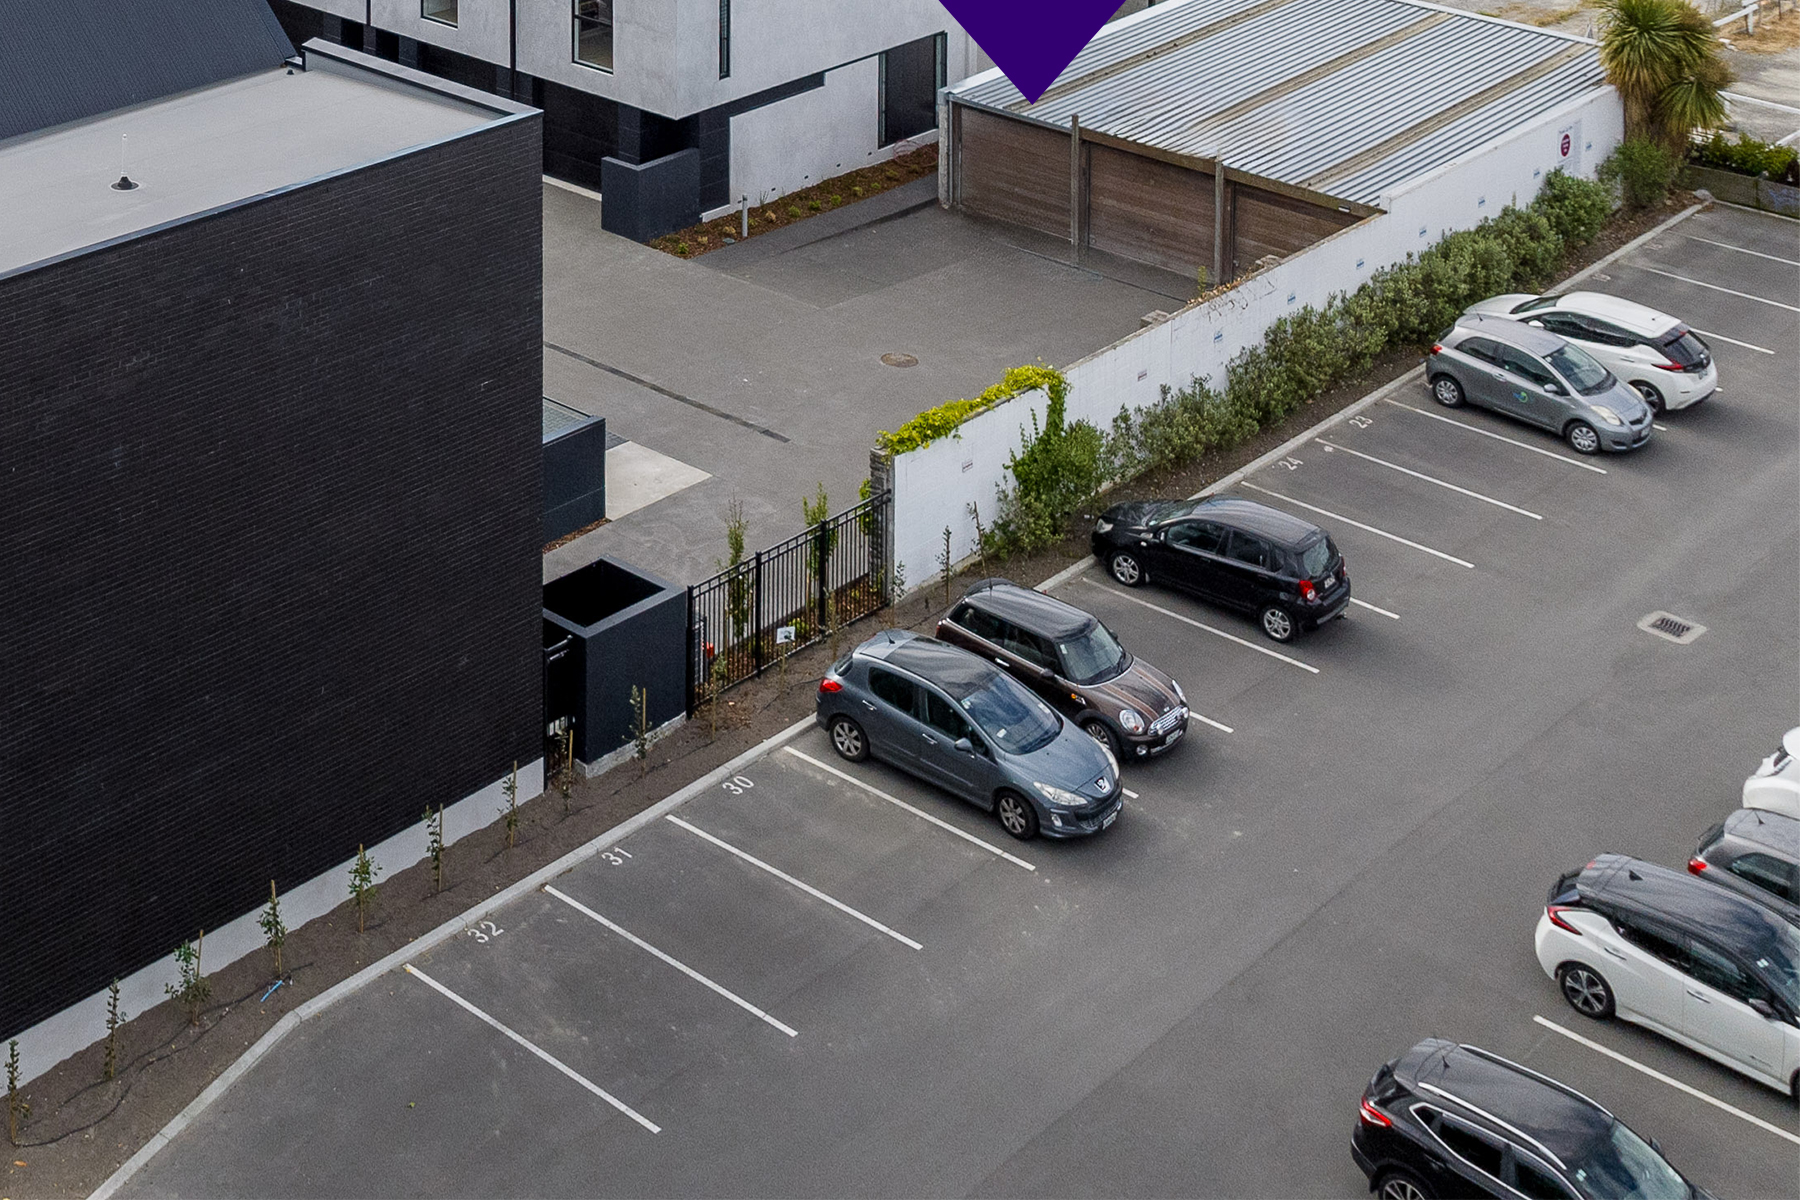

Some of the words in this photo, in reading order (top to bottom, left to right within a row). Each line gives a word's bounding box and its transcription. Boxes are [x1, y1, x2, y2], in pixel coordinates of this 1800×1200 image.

[1349, 415, 1374, 429] 23
[1278, 456, 1304, 471] 24
[722, 775, 755, 795] 30
[601, 846, 633, 866] 31
[467, 921, 504, 943] 32
